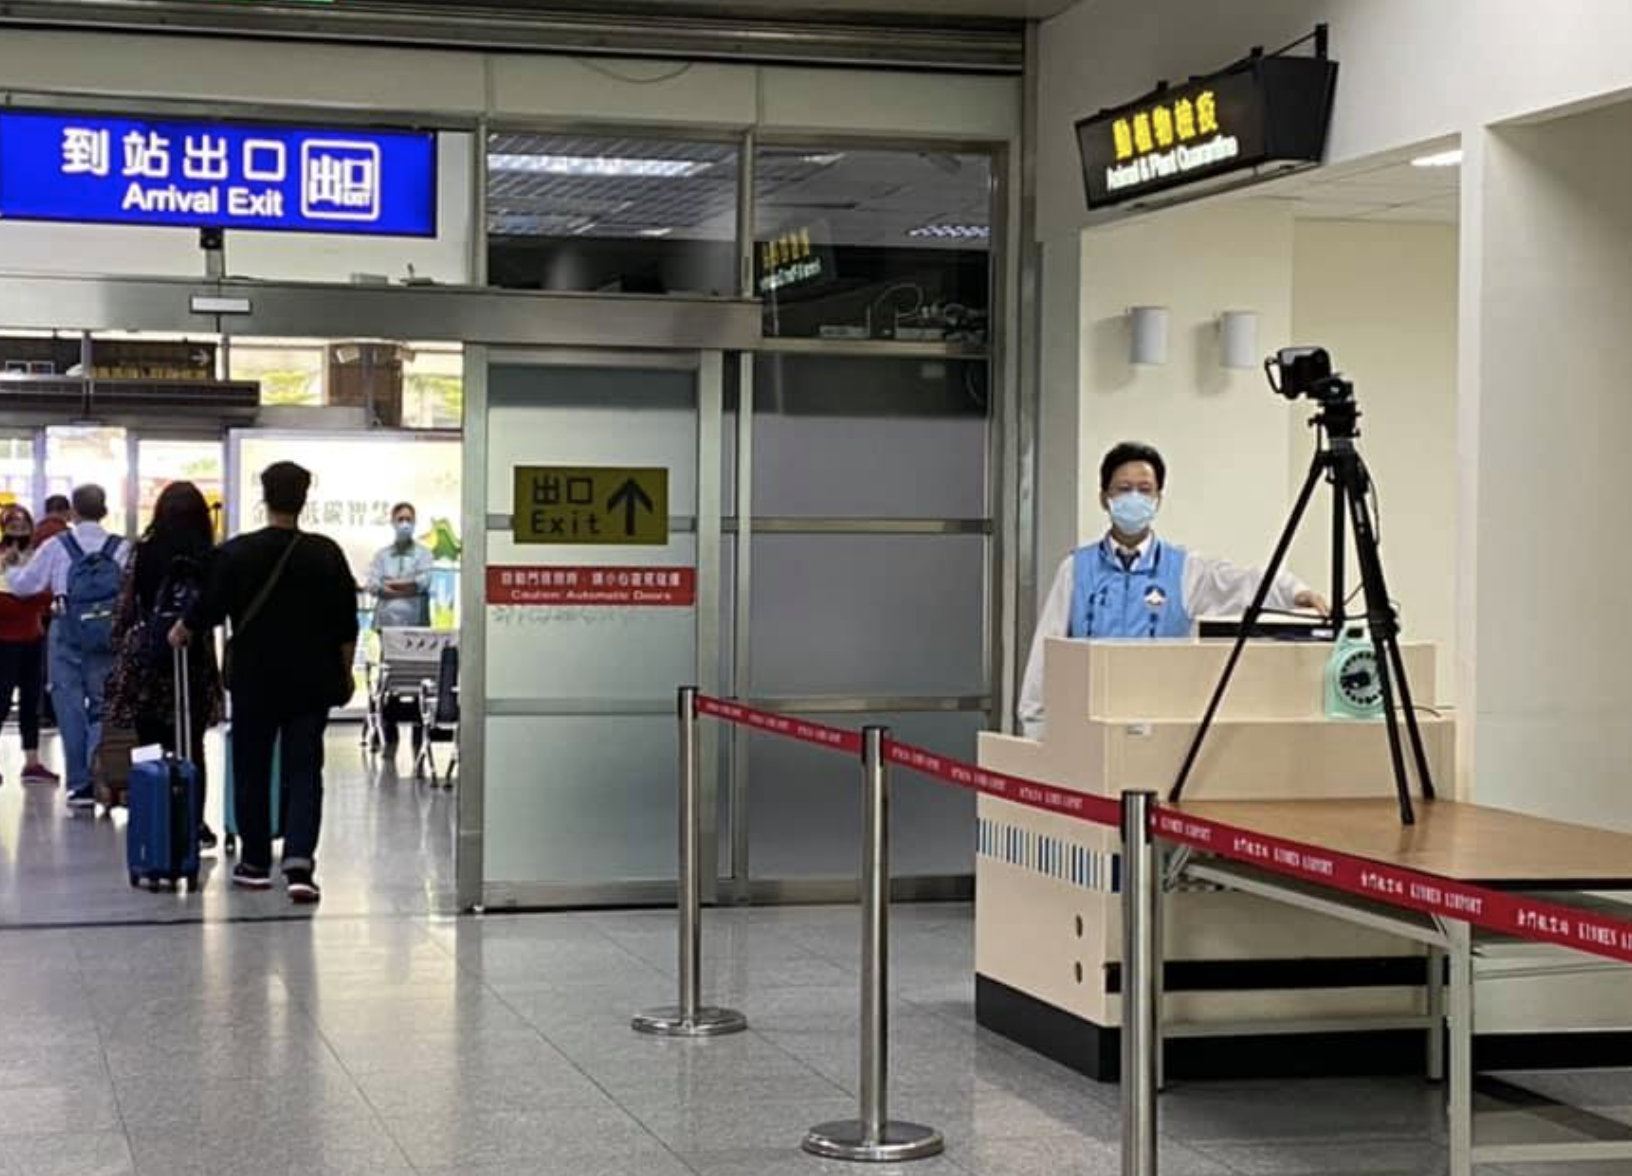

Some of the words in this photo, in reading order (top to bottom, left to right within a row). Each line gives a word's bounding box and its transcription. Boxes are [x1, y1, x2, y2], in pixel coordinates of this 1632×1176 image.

[61, 126, 287, 181] 到站出口
[122, 182, 218, 214] Arrival
[228, 187, 283, 217] Exit
[532, 474, 593, 505] 出口
[531, 510, 601, 536] Exit
[565, 588, 629, 600] Automatic
[632, 588, 671, 600] Doors
